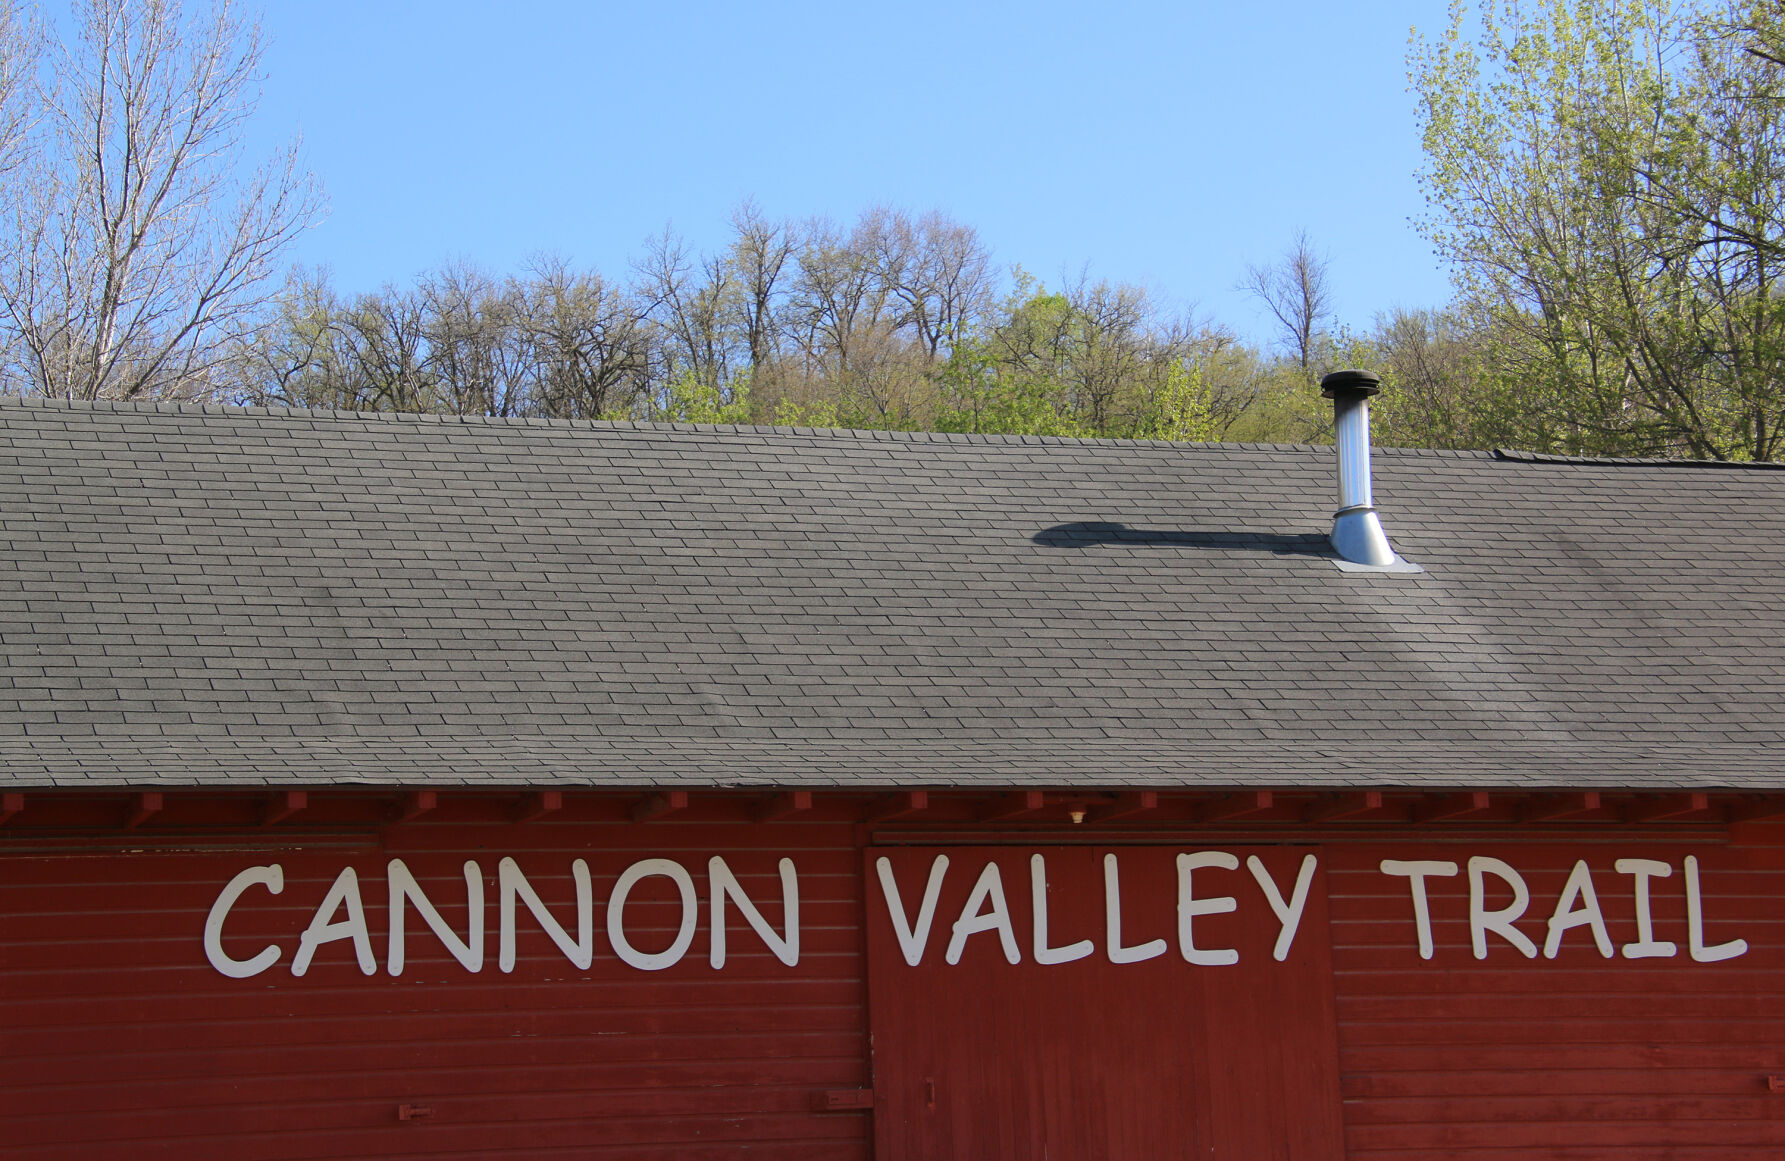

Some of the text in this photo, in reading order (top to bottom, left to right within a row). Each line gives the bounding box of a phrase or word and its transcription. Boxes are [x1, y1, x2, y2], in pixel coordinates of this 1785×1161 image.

[204, 851, 1748, 979] CANNON VALLEY TRAIL
